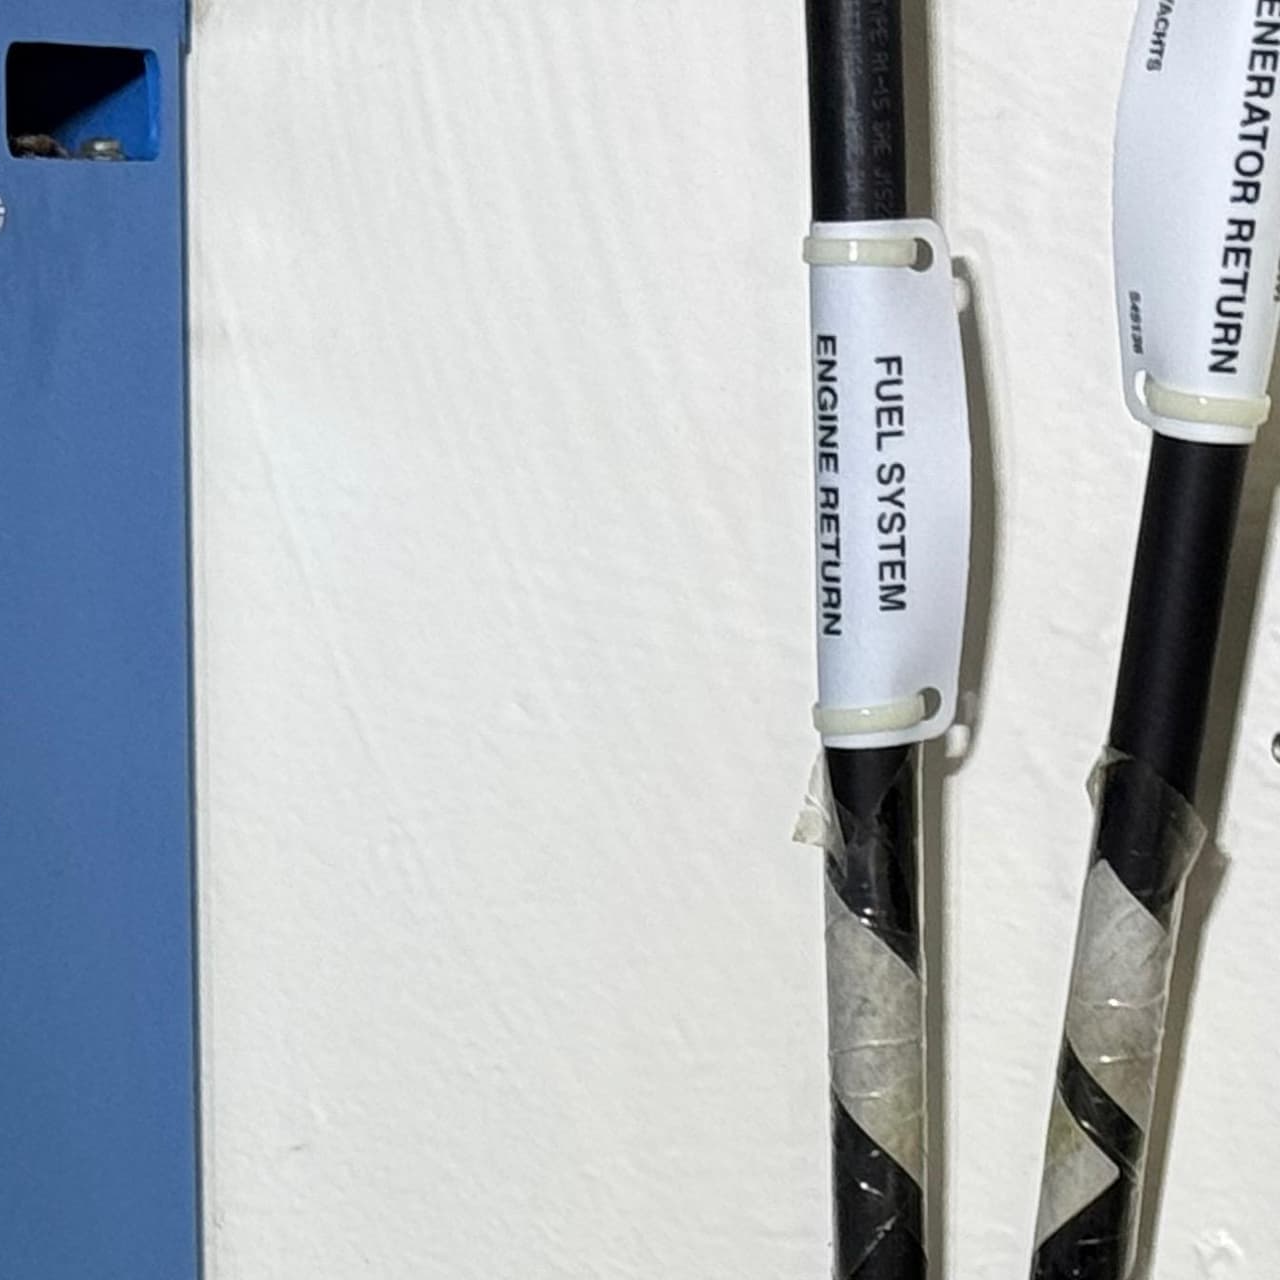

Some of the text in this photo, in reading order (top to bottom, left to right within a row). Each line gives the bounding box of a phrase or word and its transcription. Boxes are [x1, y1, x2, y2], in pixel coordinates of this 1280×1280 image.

[1208, 218, 1256, 374] RETURN
[816, 334, 842, 636] ENGINE RETURN
[874, 355, 907, 612] FUEL SYSTEM
